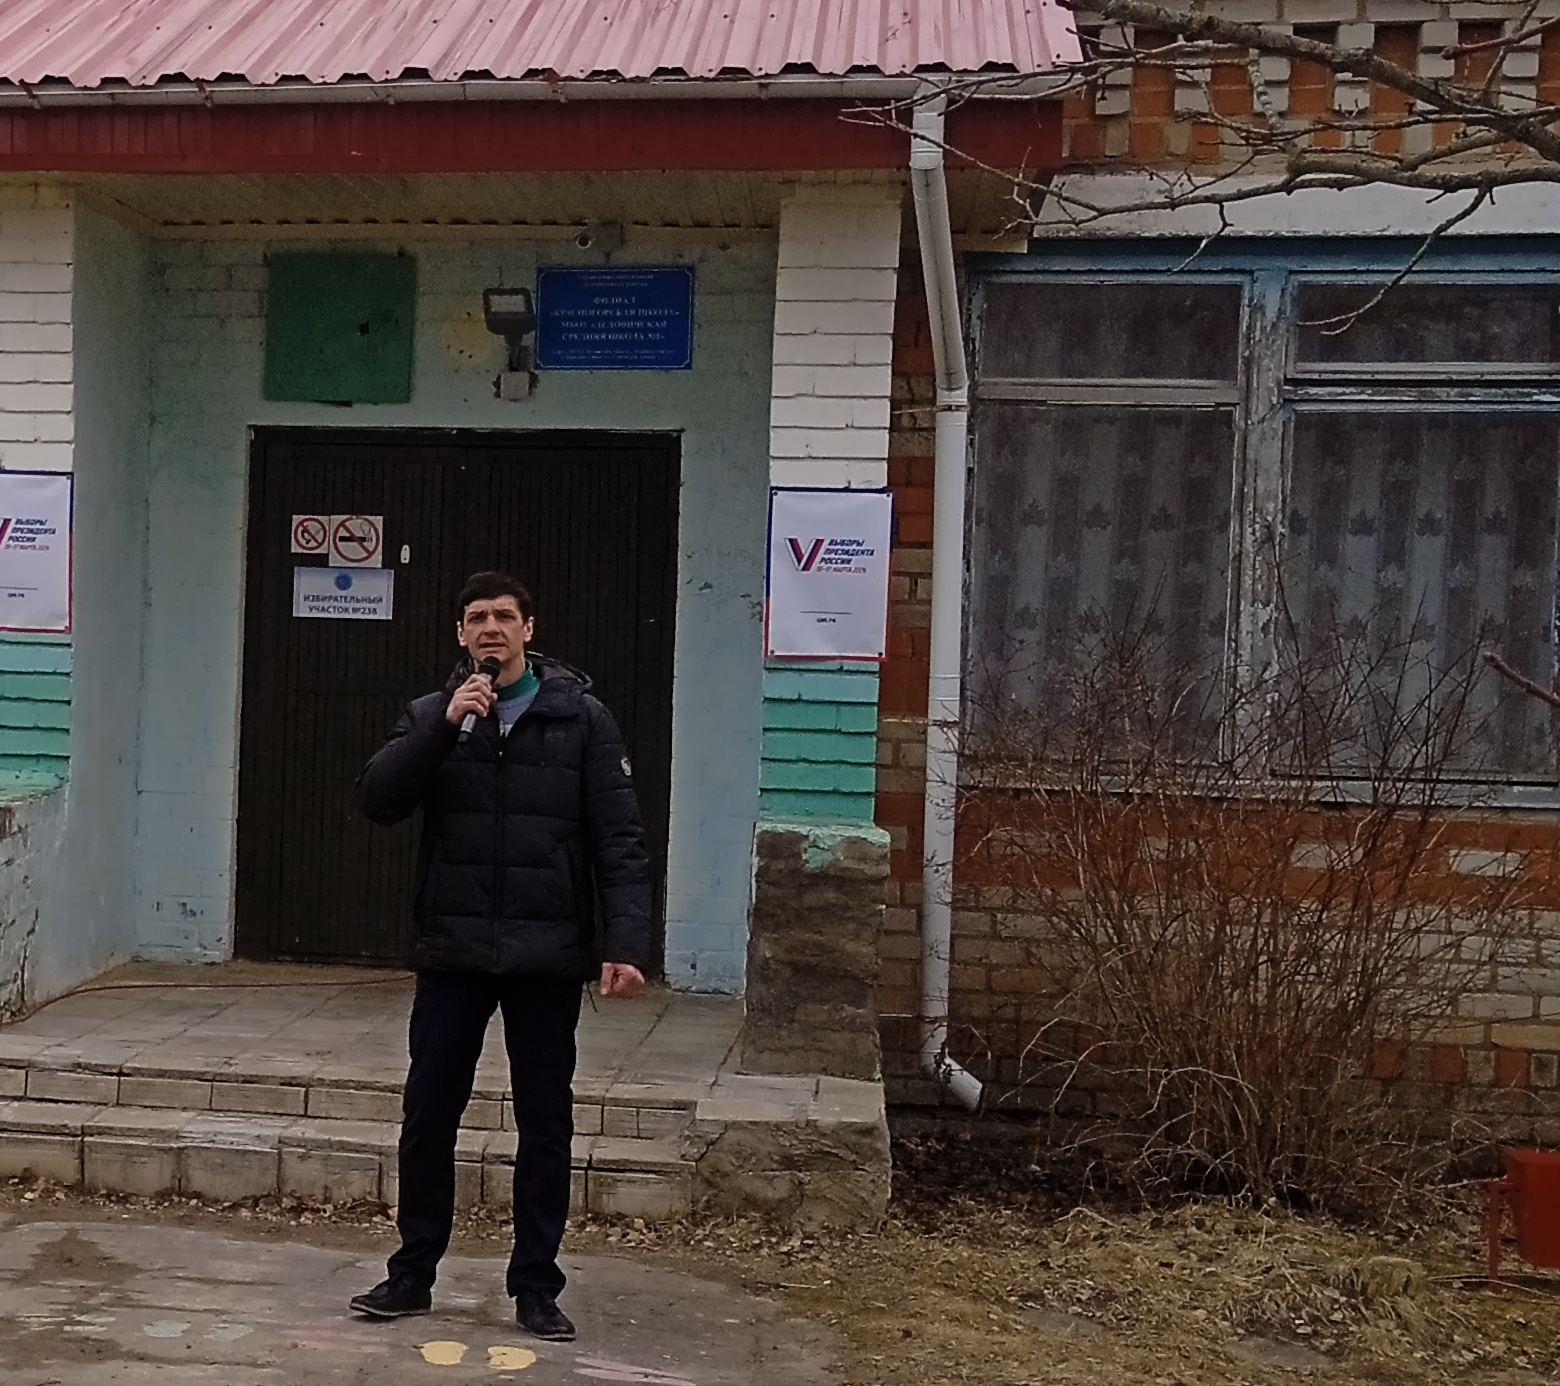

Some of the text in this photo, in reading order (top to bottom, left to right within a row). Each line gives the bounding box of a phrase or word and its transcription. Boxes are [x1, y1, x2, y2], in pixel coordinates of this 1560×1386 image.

[828, 539, 865, 547] ВЫБОРЫ
[824, 548, 875, 556] ПРЕЗИДЕНТА
[308, 605, 350, 614] УЧАСТОК
